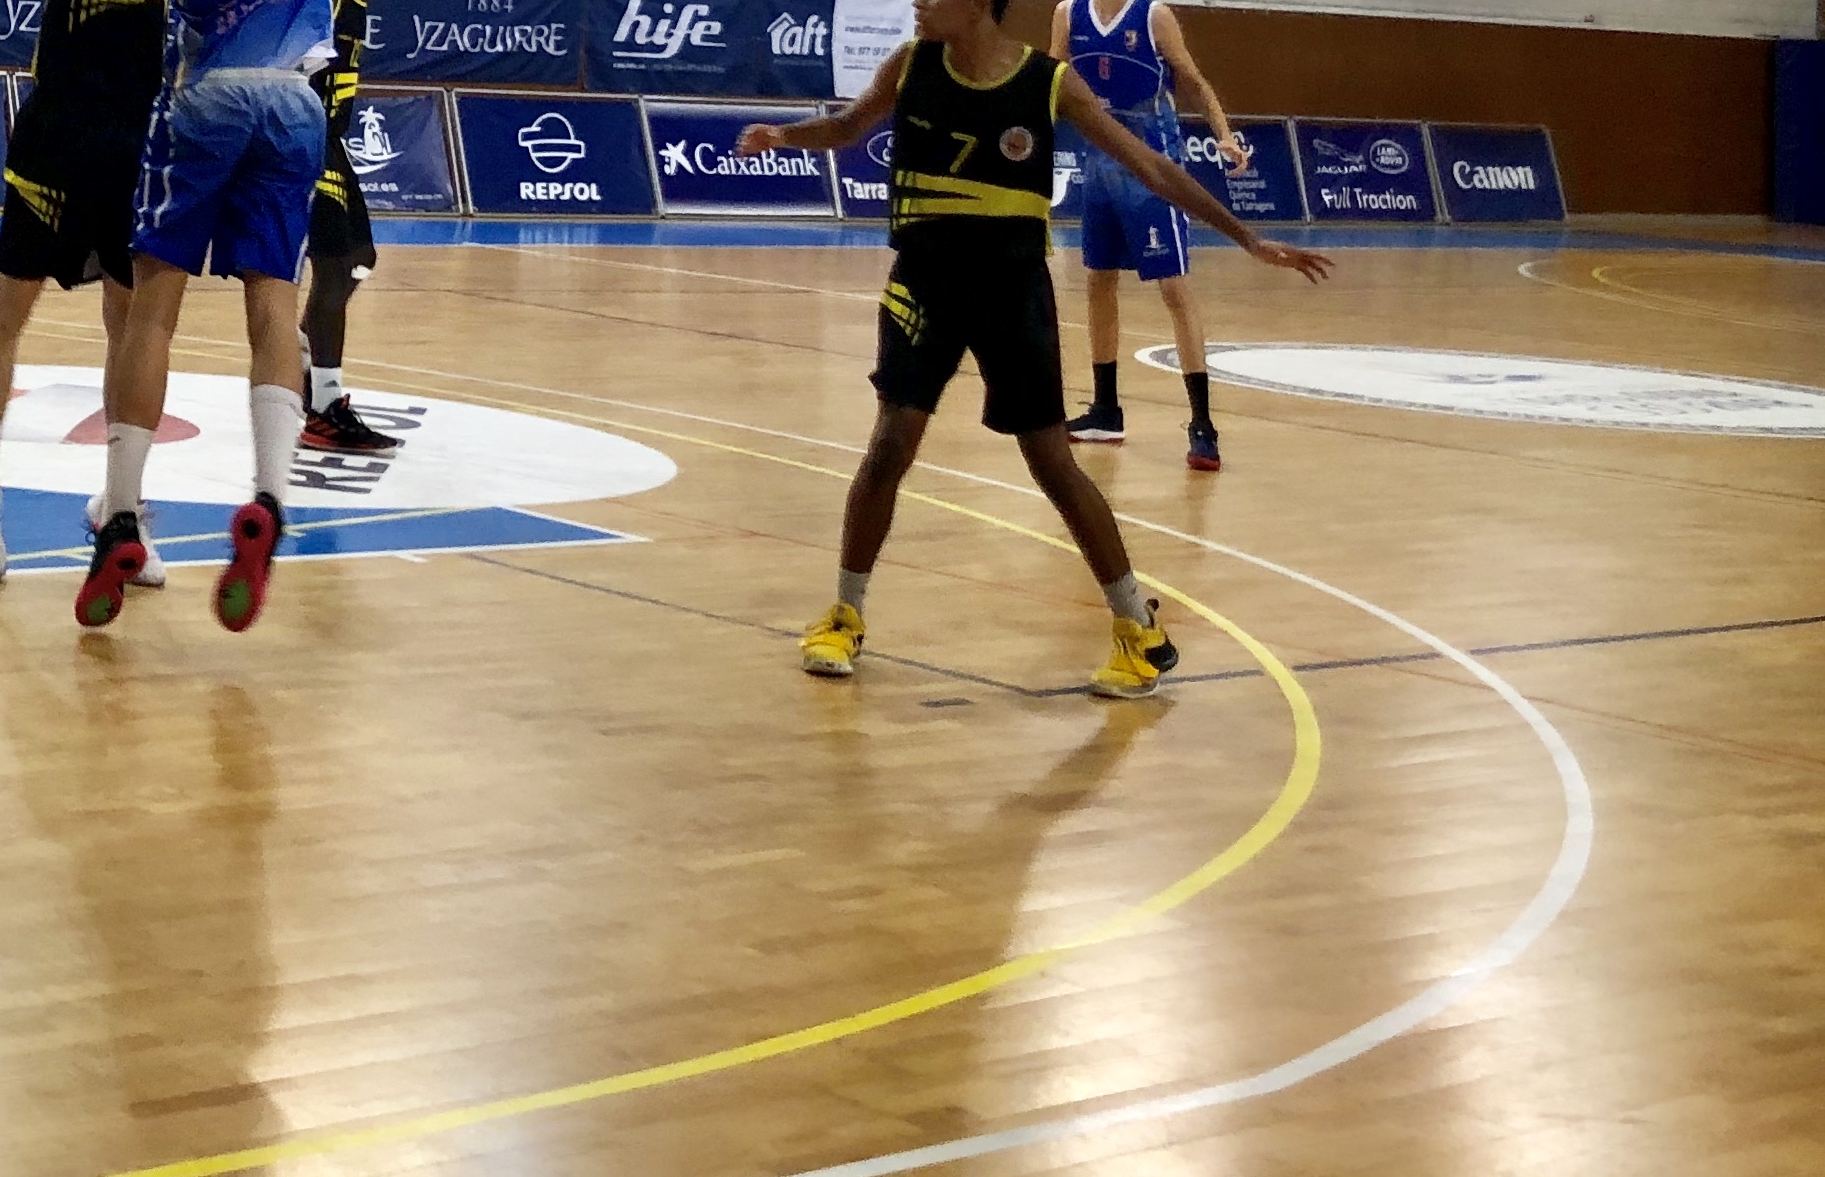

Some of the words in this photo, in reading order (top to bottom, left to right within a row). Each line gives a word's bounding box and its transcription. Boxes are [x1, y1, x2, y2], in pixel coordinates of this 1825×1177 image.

[406, 14, 568, 59] YZAGUIRRE
[694, 142, 821, 176] CaixaBank
[949, 130, 978, 174] 7
[1315, 164, 1366, 174] JAGUAR
[1453, 160, 1535, 191] Canon
[519, 181, 602, 201] REPSOL
[841, 176, 888, 200] Tarra
[1321, 186, 1352, 209] Full
[1354, 187, 1417, 210] Traction
[288, 403, 428, 494] REOL
